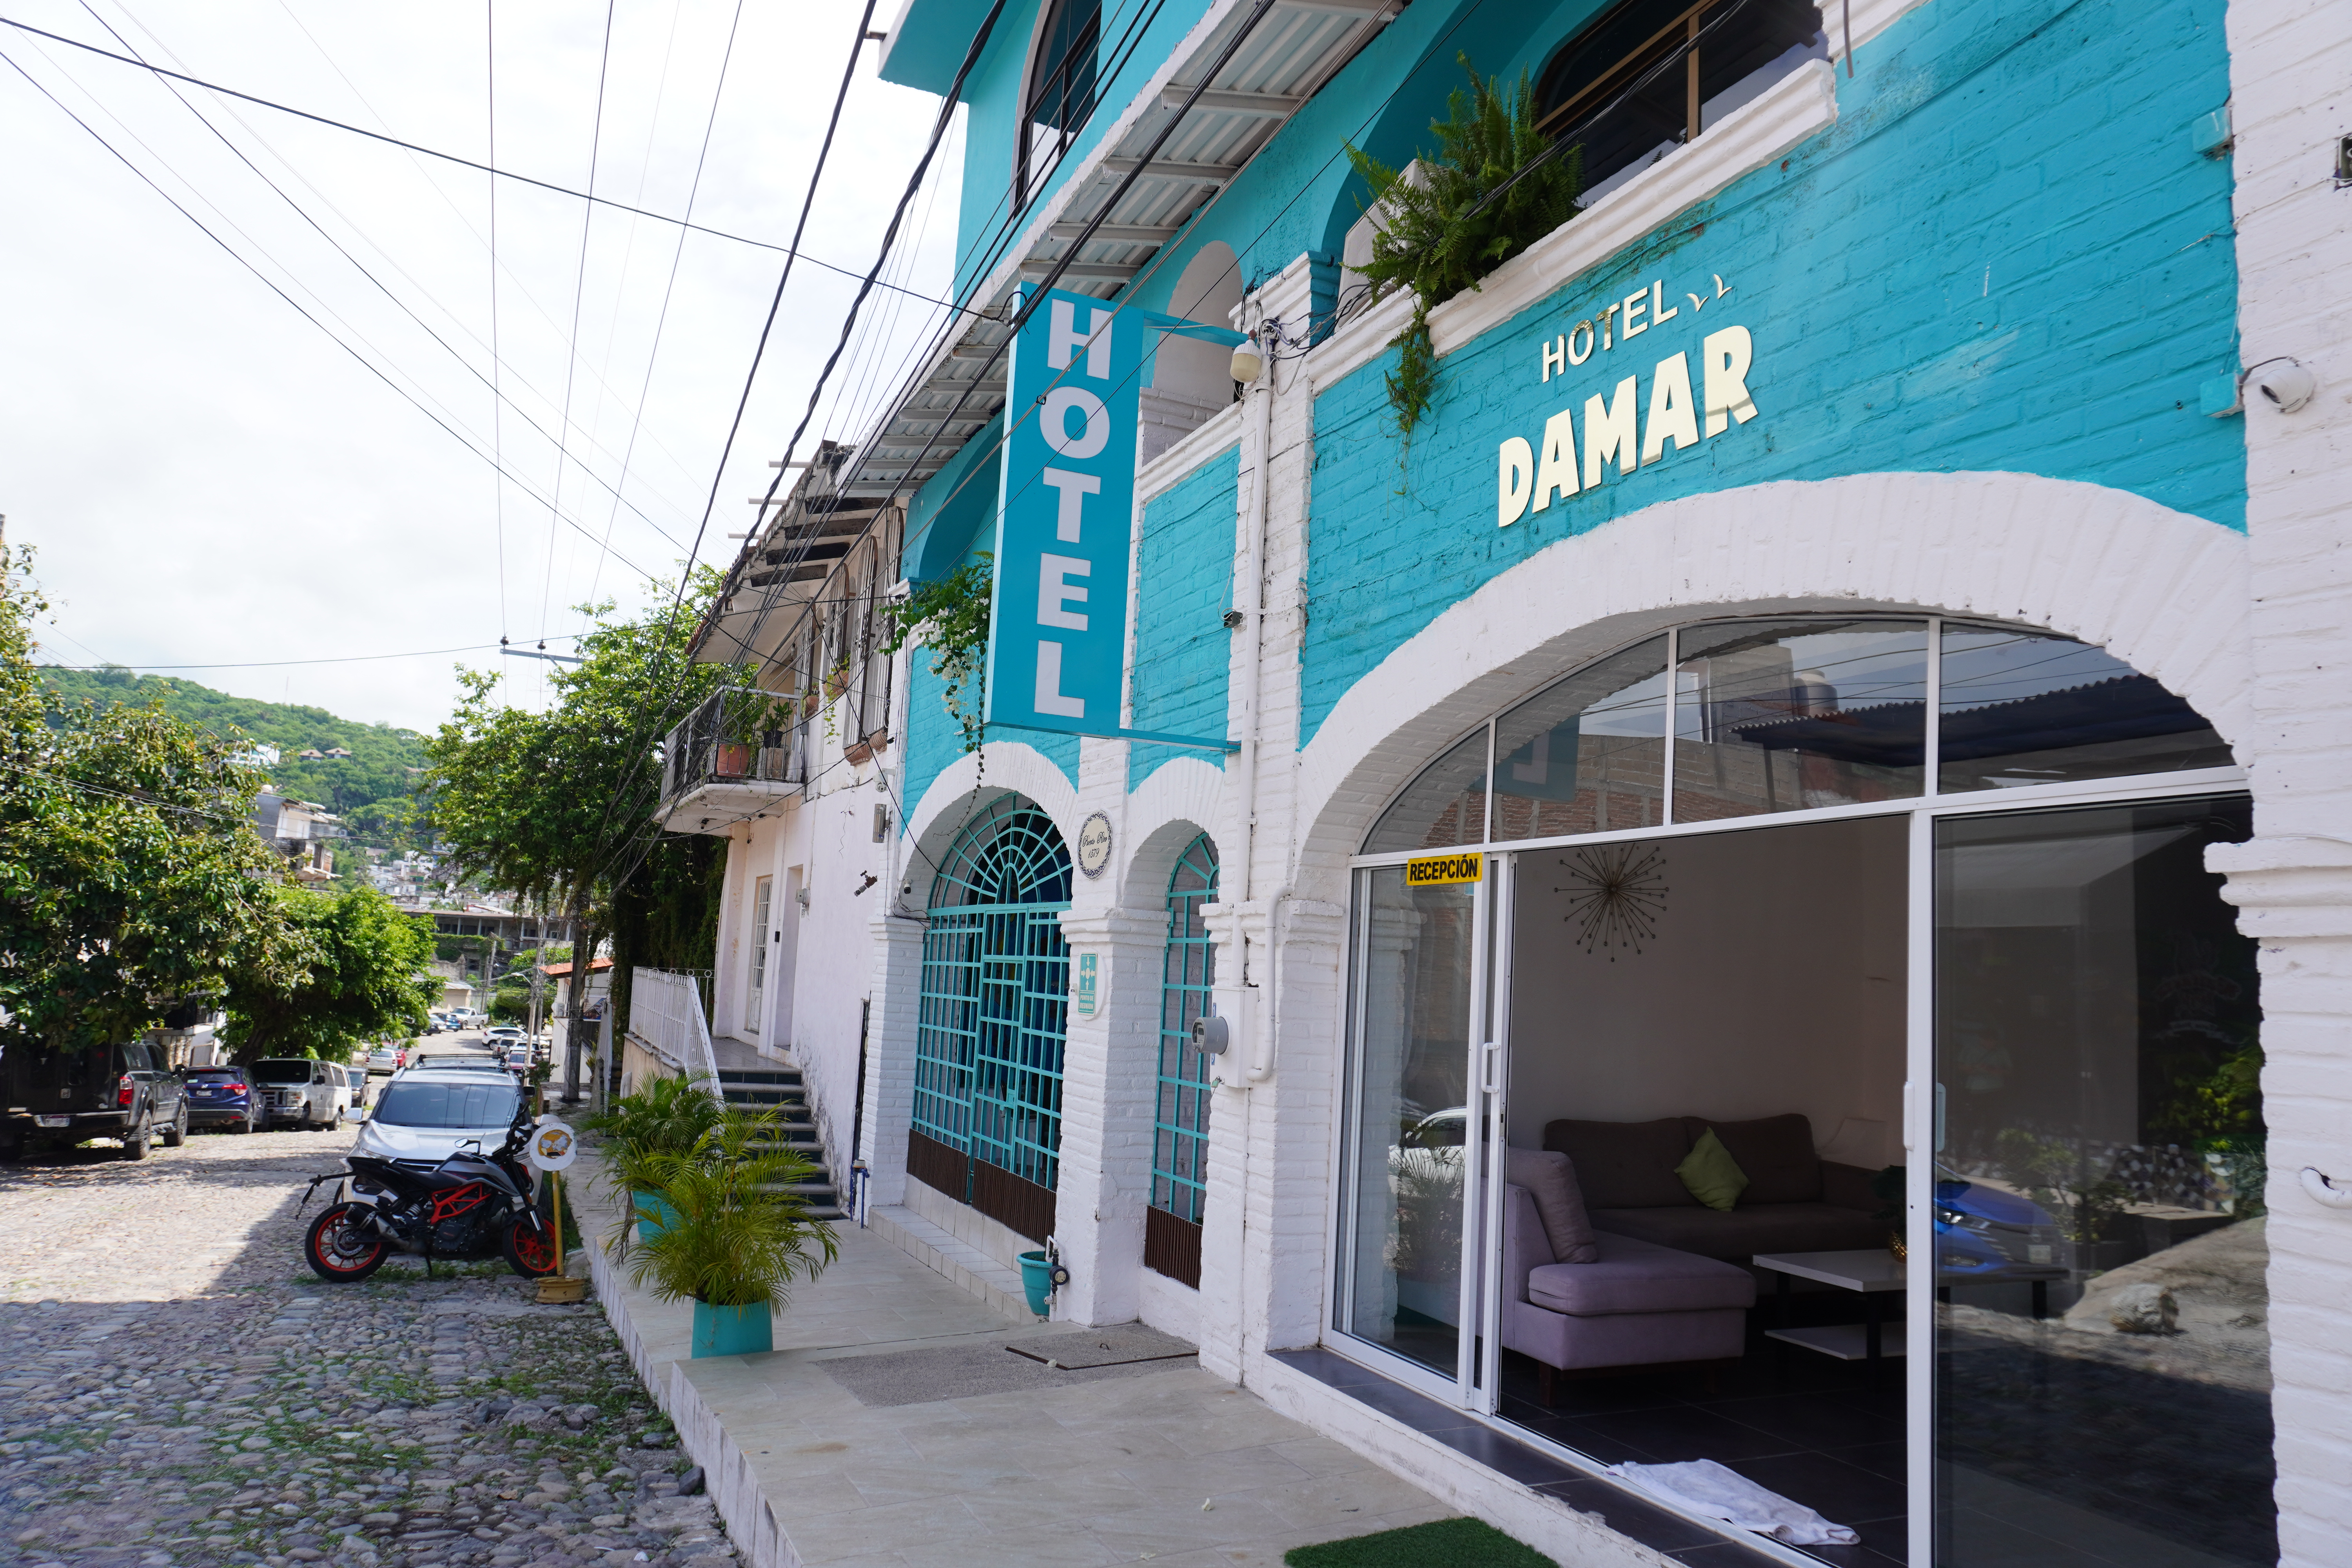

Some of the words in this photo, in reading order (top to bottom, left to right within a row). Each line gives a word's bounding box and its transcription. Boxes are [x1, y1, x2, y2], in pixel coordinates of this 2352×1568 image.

[1542, 279, 1678, 383] HOTEL
[1498, 325, 1758, 528] DAMAR
[1034, 298, 1113, 719] HOTEL
[1088, 848, 1100, 858] 1579
[1410, 854, 1478, 882] RECEPCIÓN
